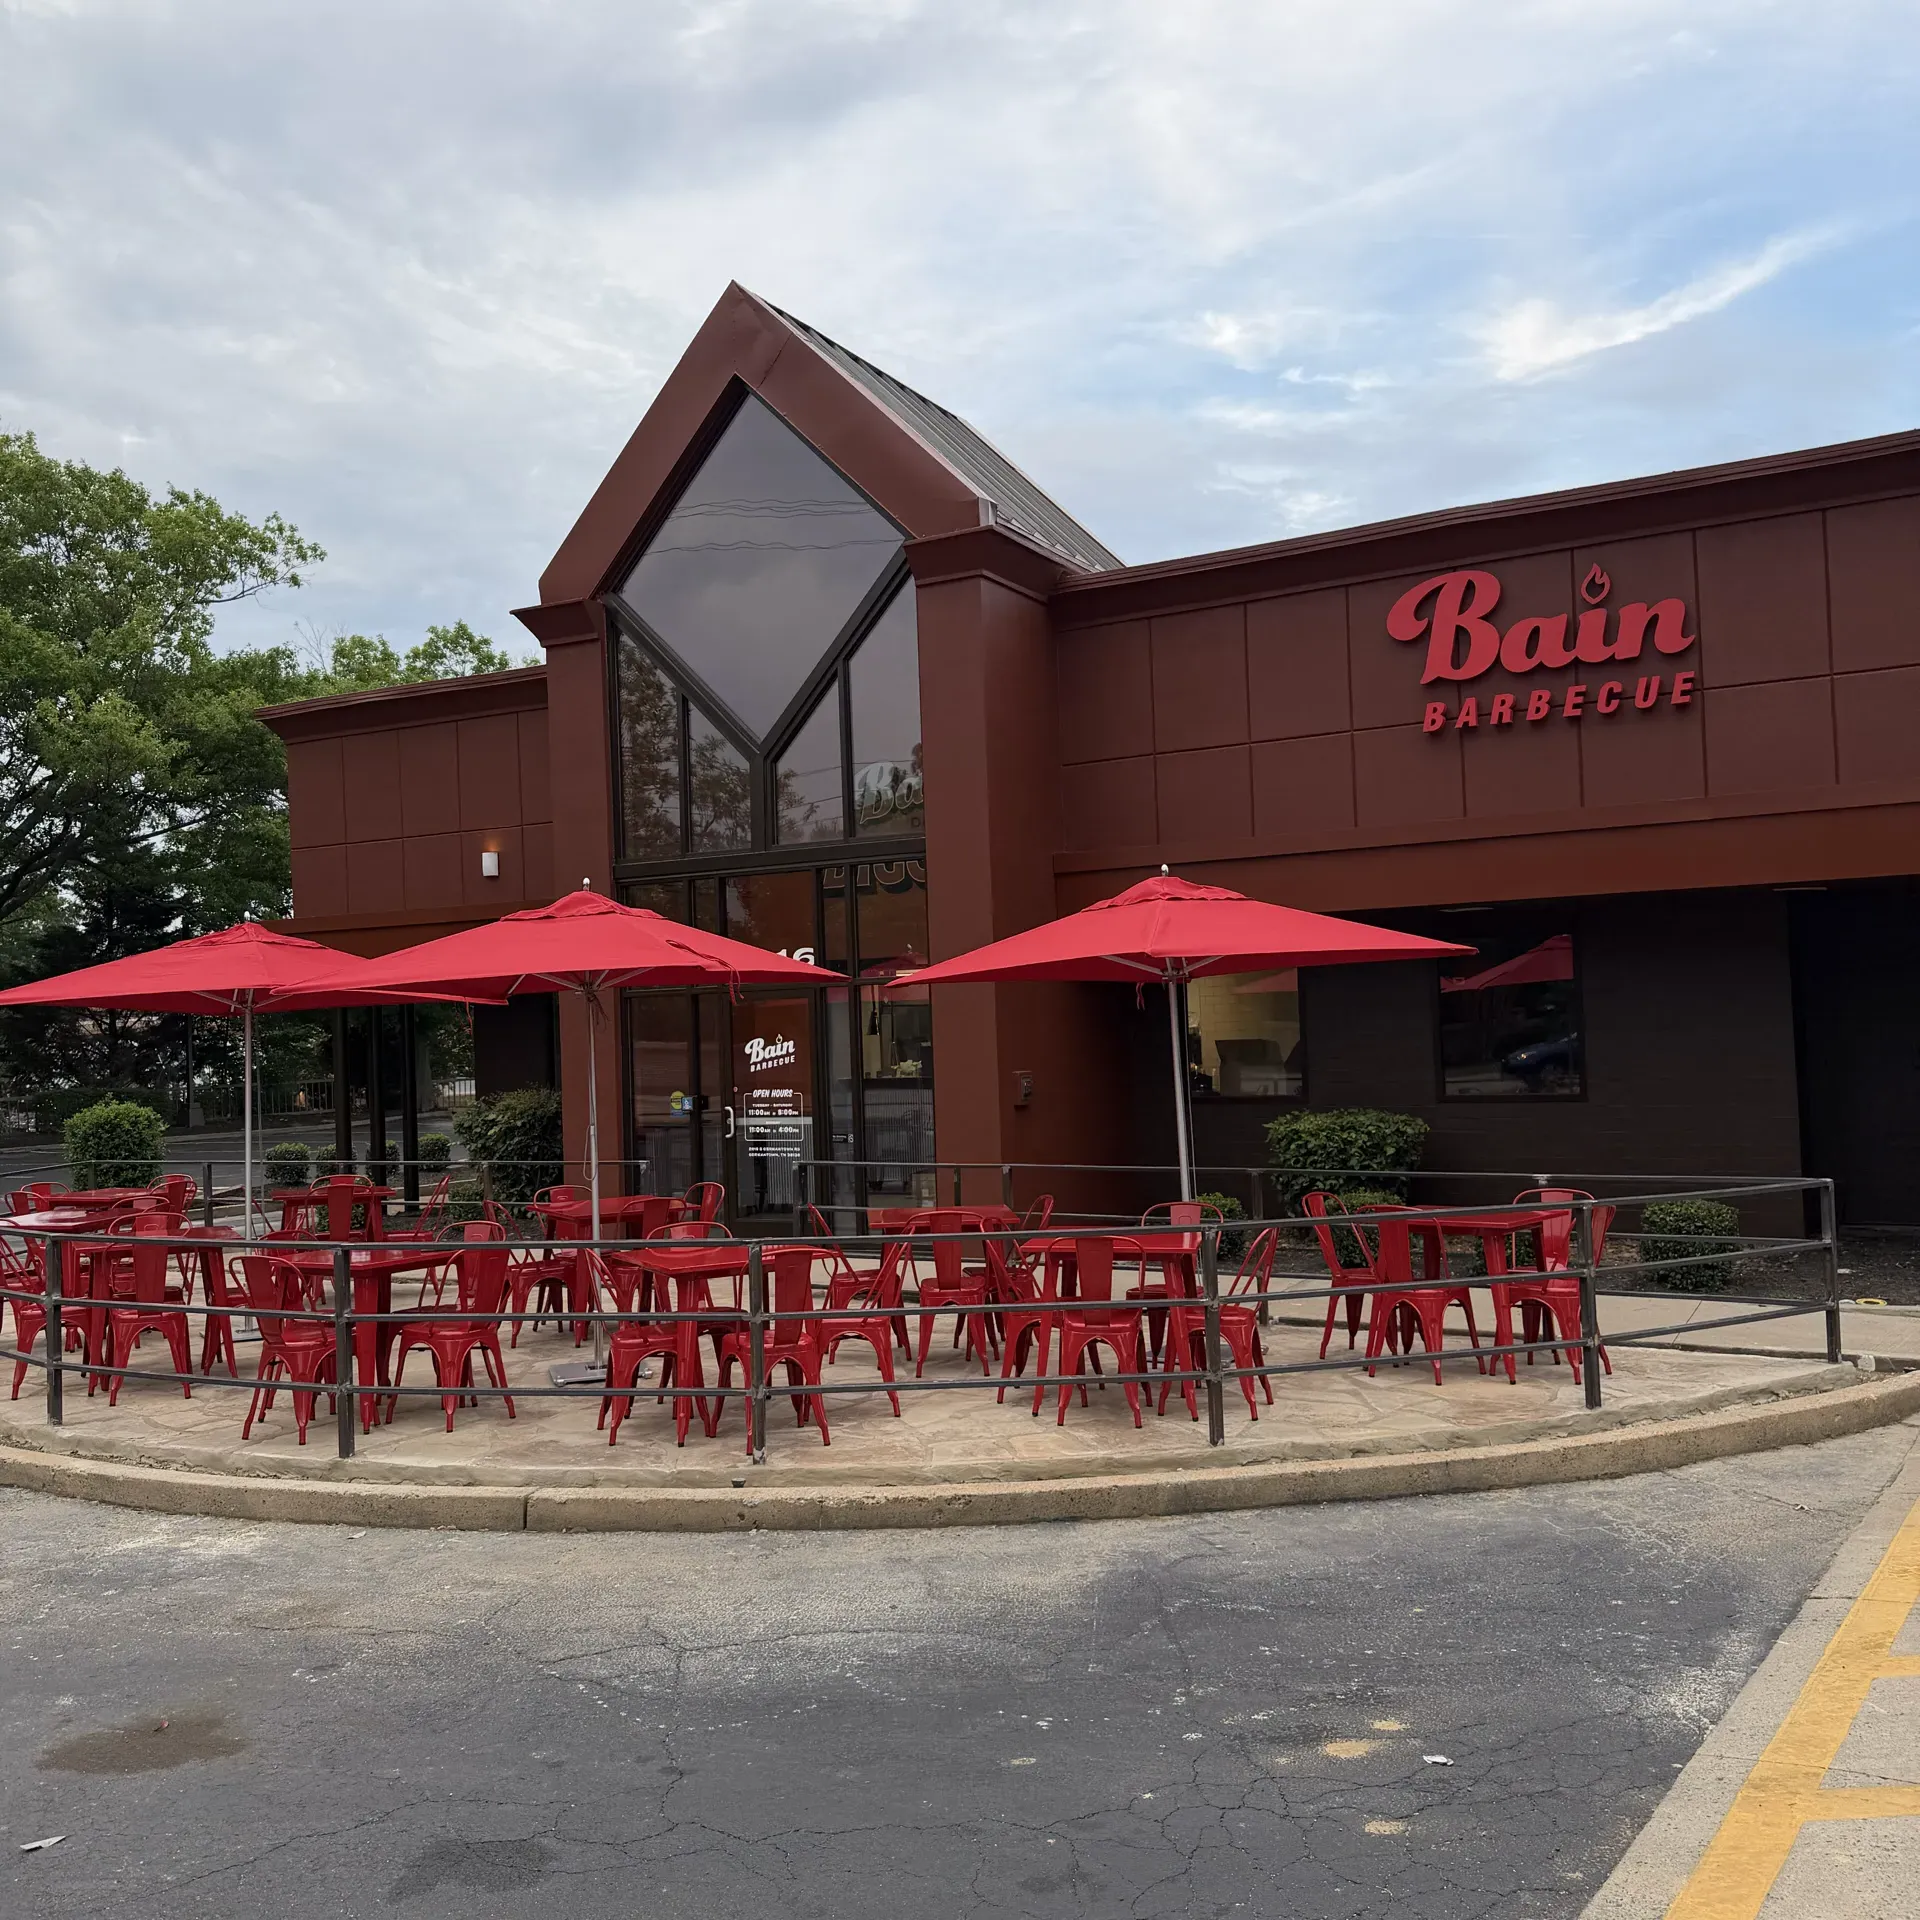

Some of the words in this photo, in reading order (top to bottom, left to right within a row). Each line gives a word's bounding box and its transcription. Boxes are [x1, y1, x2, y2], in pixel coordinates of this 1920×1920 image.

[1386, 562, 1696, 685] Bain
[1422, 671, 1696, 733] BARBECUE
[745, 1034, 795, 1064] Bain
[750, 1055, 795, 1072] BARBECUE
[753, 1089, 770, 1097] OPEN
[771, 1089, 793, 1097] HOURS
